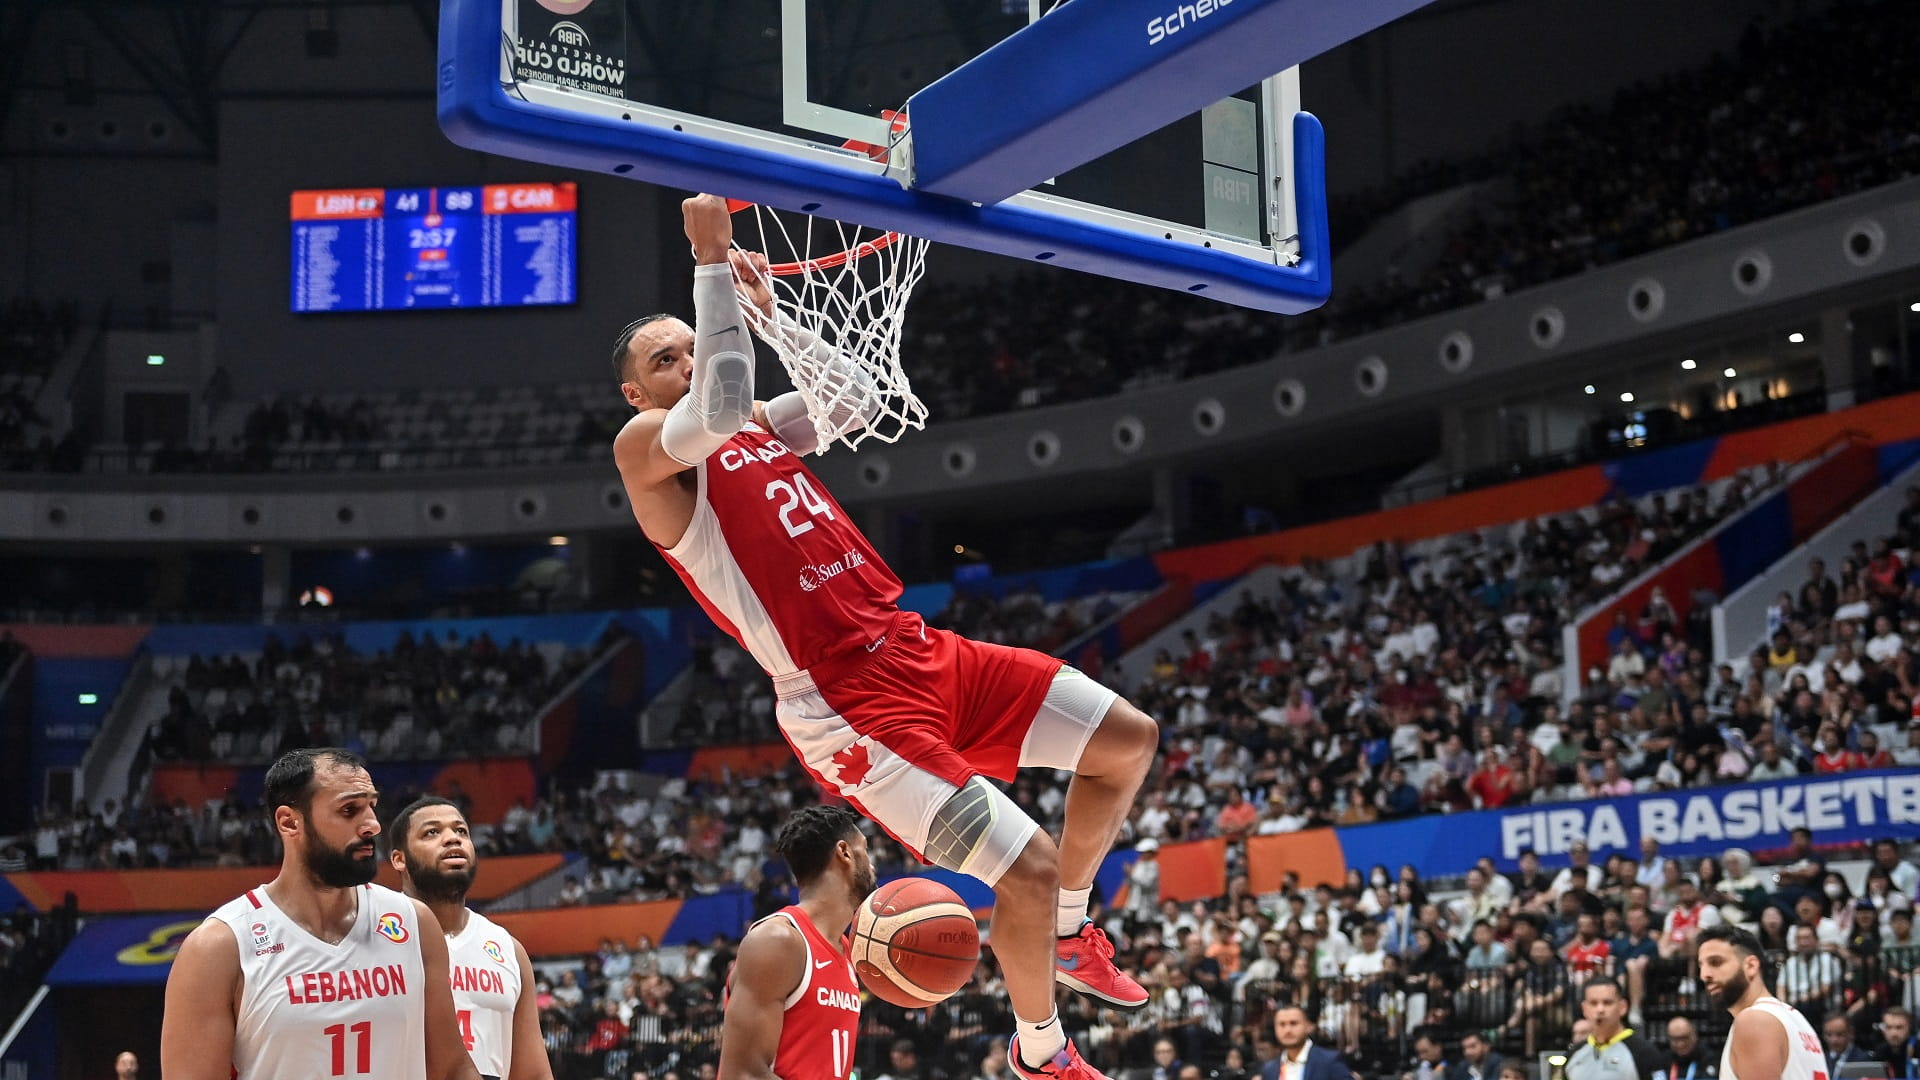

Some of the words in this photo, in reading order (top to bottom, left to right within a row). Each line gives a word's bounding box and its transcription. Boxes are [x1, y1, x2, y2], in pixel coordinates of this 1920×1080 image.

[765, 471, 835, 538] 24
[819, 560, 844, 581] Sun
[1502, 804, 1629, 860] FIBA
[1639, 774, 1920, 846] BASKETB
[254, 934, 271, 945] LBF
[285, 964, 407, 1005] LEBANON
[448, 966, 504, 995] ANON
[816, 987, 861, 1013] CANAD
[323, 1021, 372, 1077] 11
[831, 1028, 849, 1078] 11
